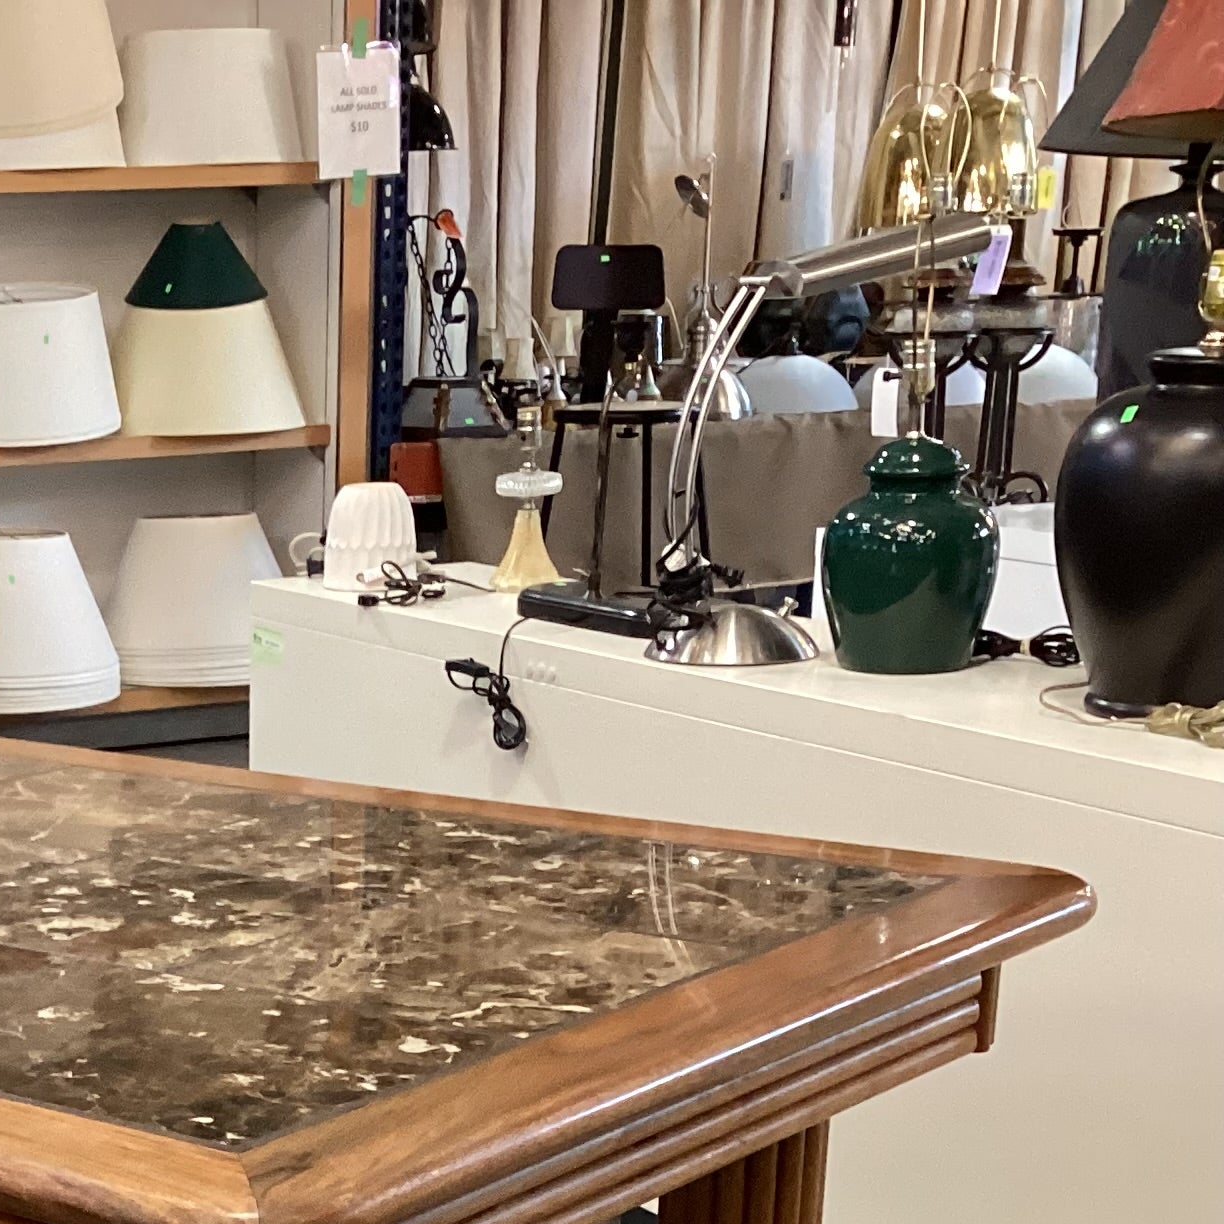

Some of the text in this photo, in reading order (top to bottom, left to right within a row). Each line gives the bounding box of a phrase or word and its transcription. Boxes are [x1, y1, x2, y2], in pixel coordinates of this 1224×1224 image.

[340, 87, 353, 96] ALL
[331, 101, 387, 113] LAMP SHADES
[350, 121, 369, 132] $10
